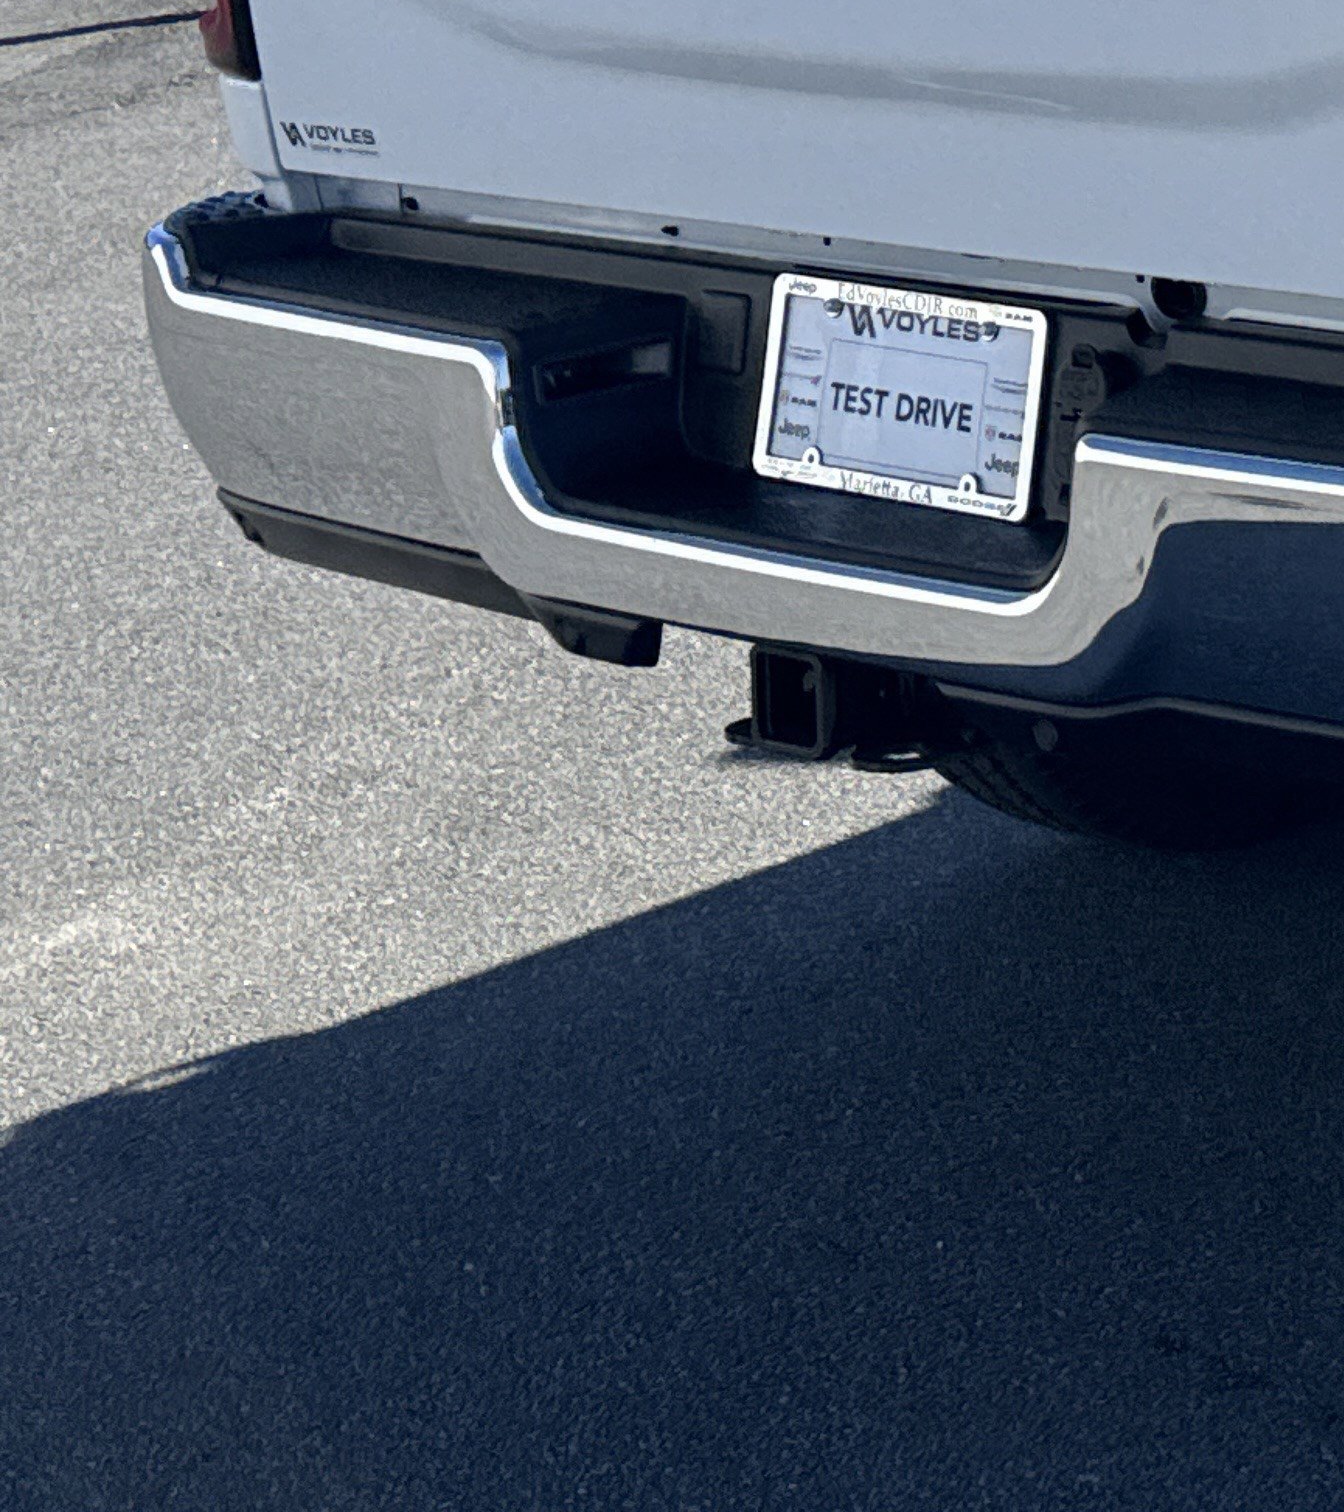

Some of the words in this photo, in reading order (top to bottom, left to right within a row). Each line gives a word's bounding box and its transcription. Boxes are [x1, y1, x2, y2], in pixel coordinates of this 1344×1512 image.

[302, 122, 376, 145] VOYLES
[788, 279, 818, 295] Jeep
[837, 281, 979, 319] EdVoylesCDJRcom
[877, 305, 981, 343] VOYLES
[831, 381, 889, 419] TEST
[895, 392, 973, 433] DRIVE
[777, 417, 812, 440] Jeep
[984, 452, 1020, 479] Jeep
[908, 483, 934, 505] GA
